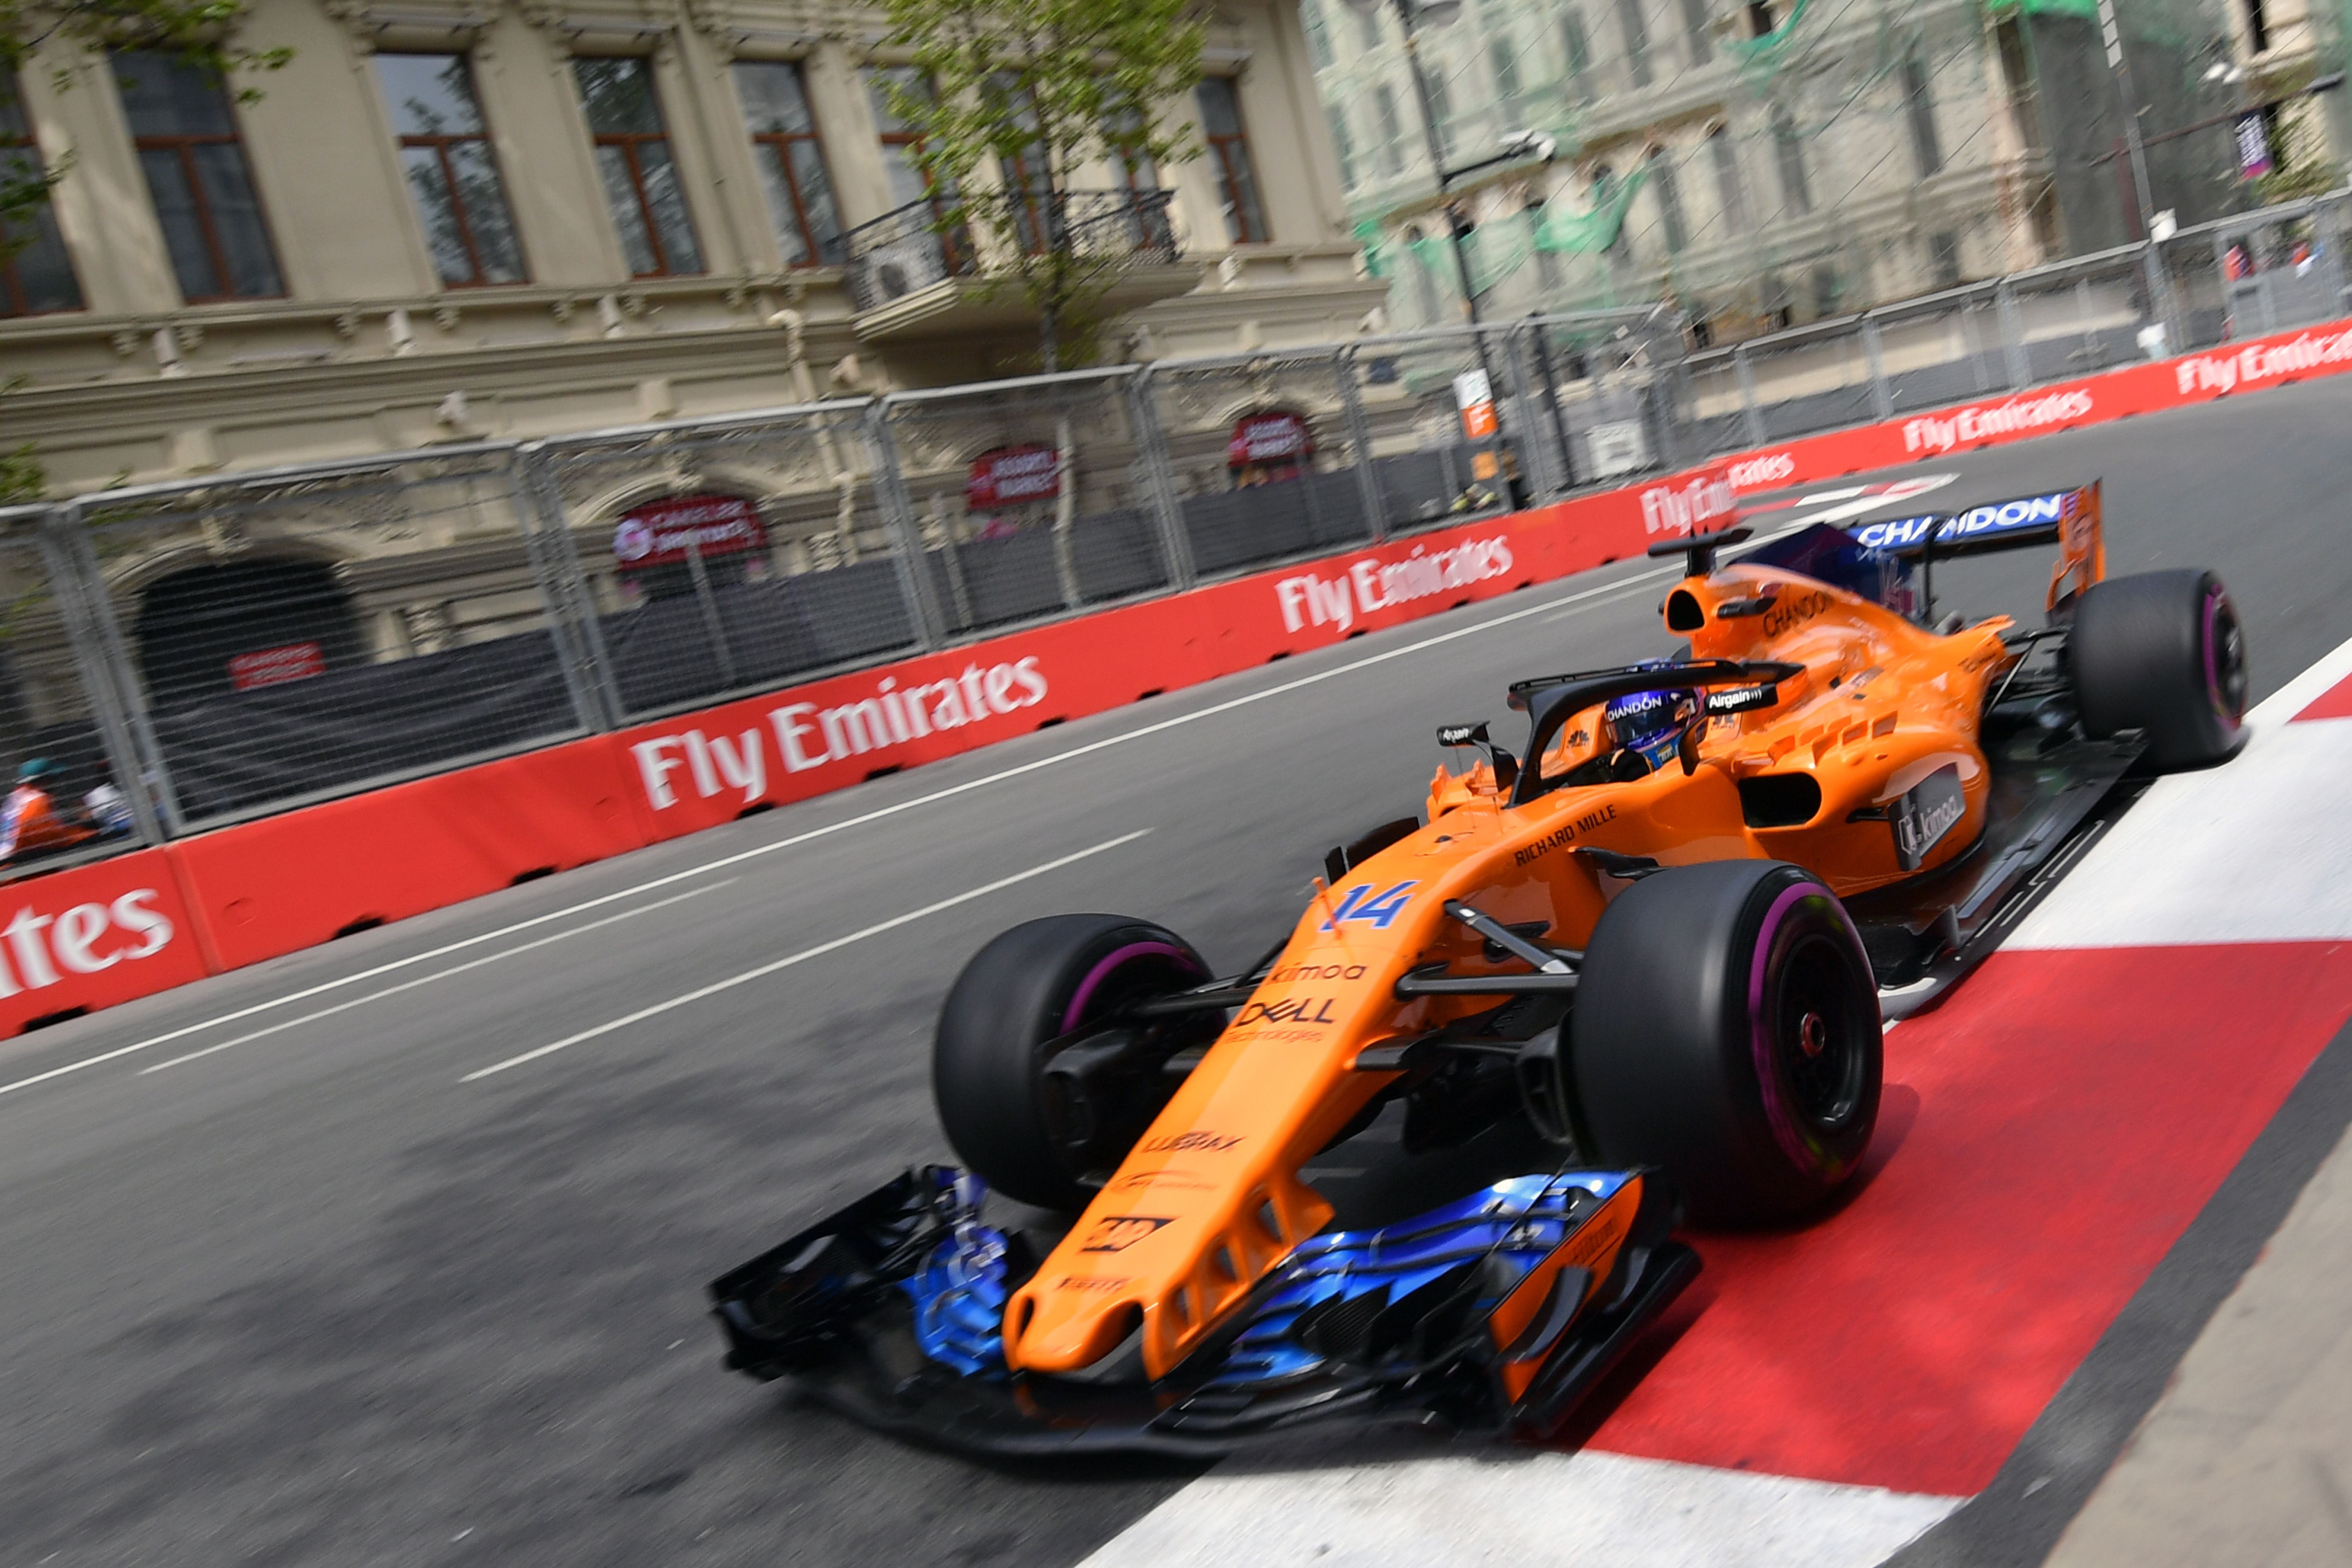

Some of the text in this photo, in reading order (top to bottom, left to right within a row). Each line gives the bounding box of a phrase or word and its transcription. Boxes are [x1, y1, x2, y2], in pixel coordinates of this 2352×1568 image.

[2175, 355, 2238, 395] Fly
[1901, 388, 2093, 452] Fly Emirates
[1639, 485, 1691, 536] Fly
[1273, 534, 1514, 634] Fly Emirates
[1608, 695, 1662, 722] CHANDON
[1709, 690, 1750, 710] Airgain
[630, 655, 1048, 811] Fly Emirates
[1514, 804, 1617, 867] RICHARD MILLE
[1919, 795, 1957, 842] kimoa
[1316, 880, 1422, 933] 14
[1233, 997, 1337, 1028] DELL
